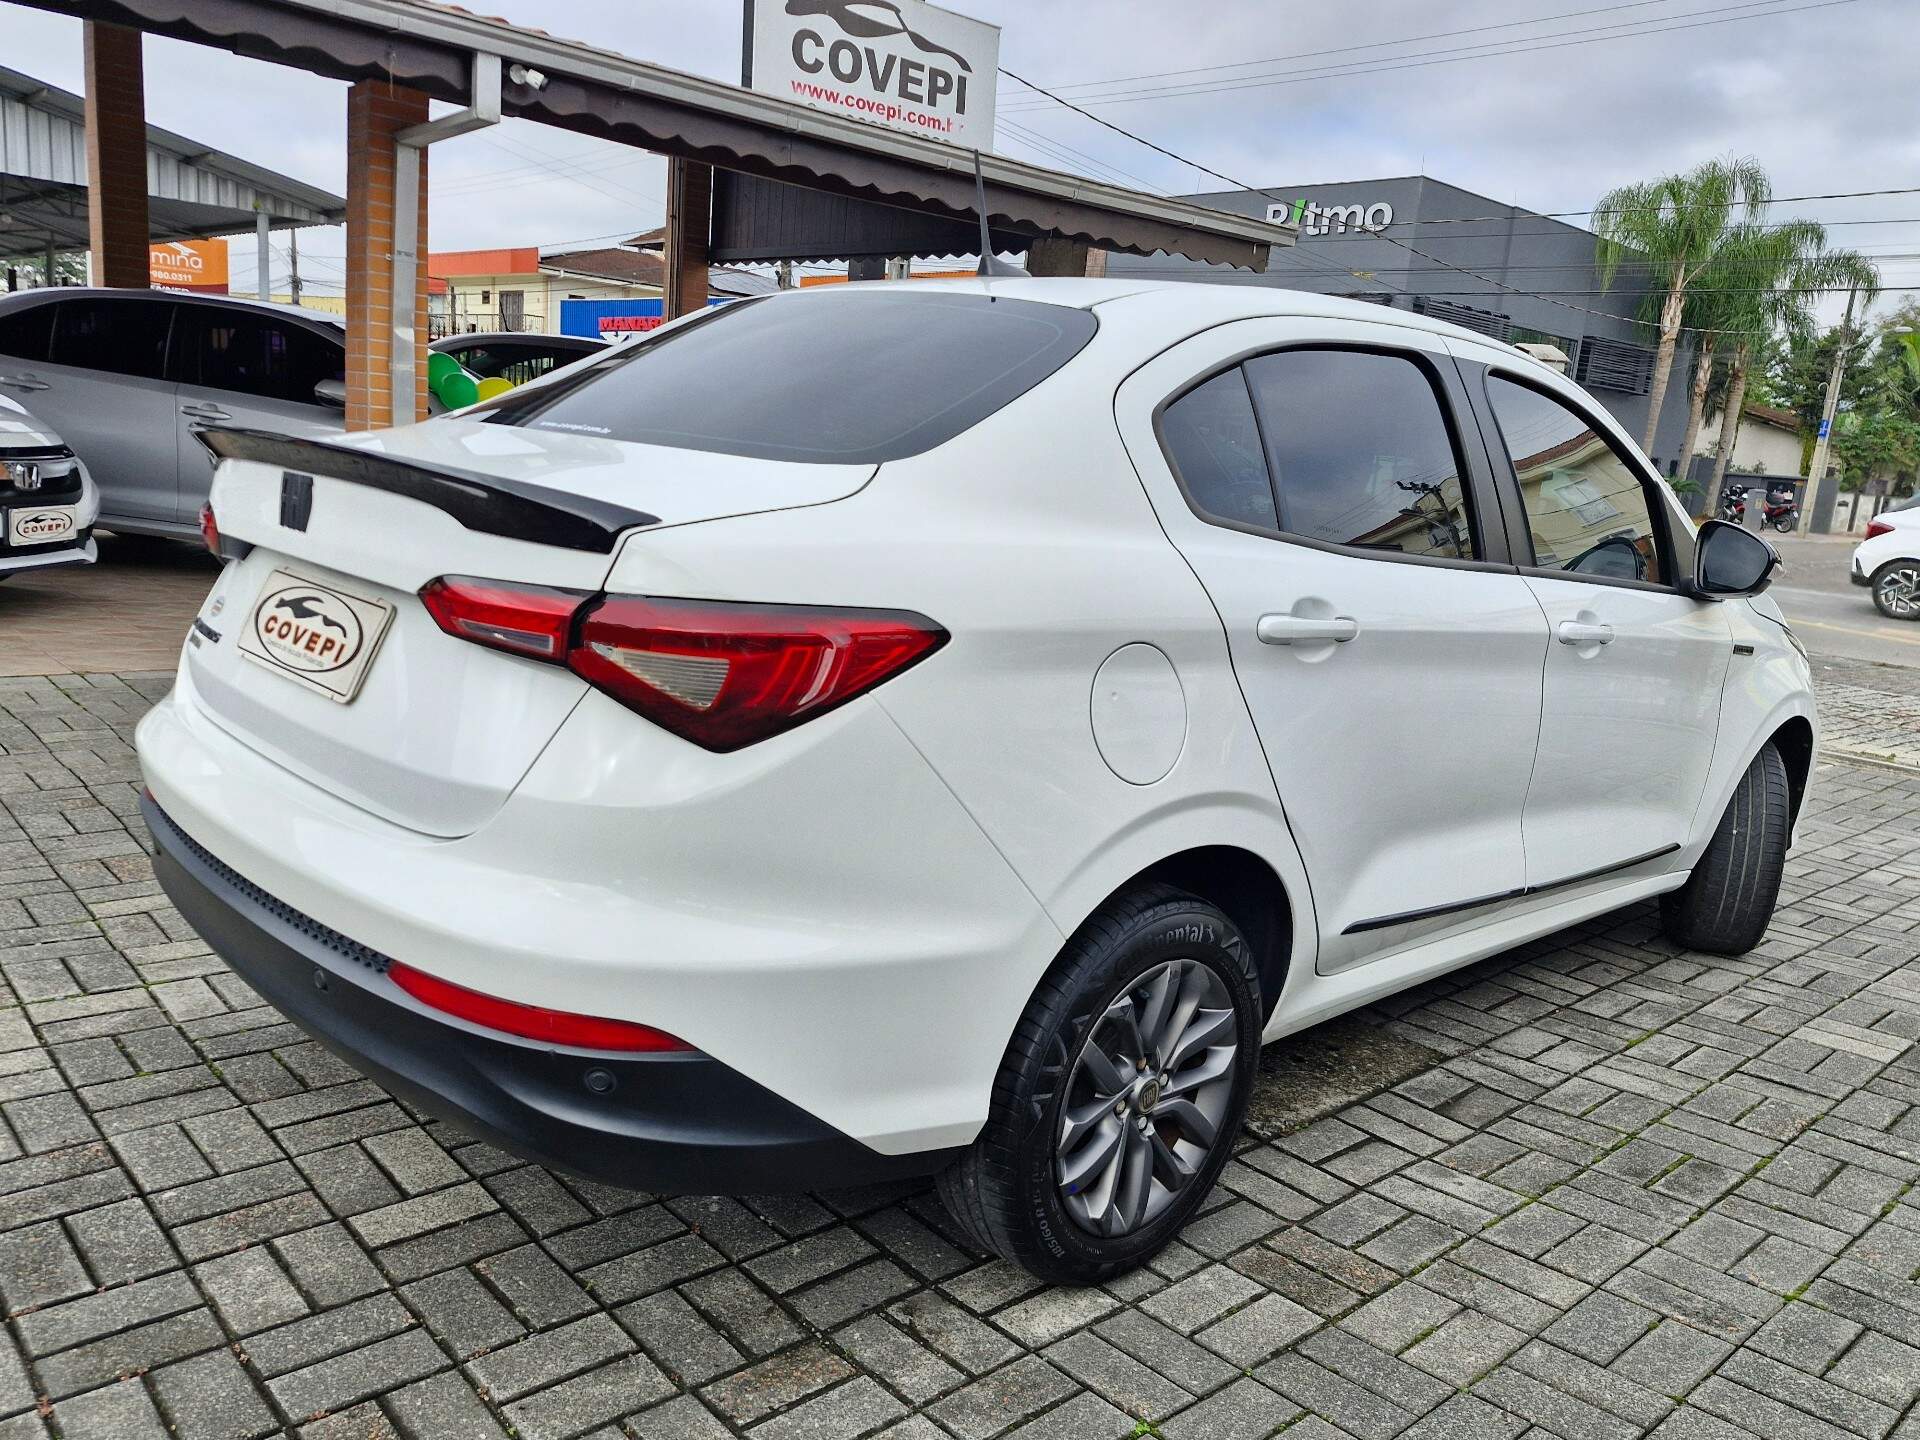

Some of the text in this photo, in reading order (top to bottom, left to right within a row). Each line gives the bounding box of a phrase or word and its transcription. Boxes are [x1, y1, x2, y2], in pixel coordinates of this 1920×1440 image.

[791, 28, 967, 115] COVEPI
[23, 523, 66, 534] COVEPI
[263, 614, 347, 664] COVEPI
